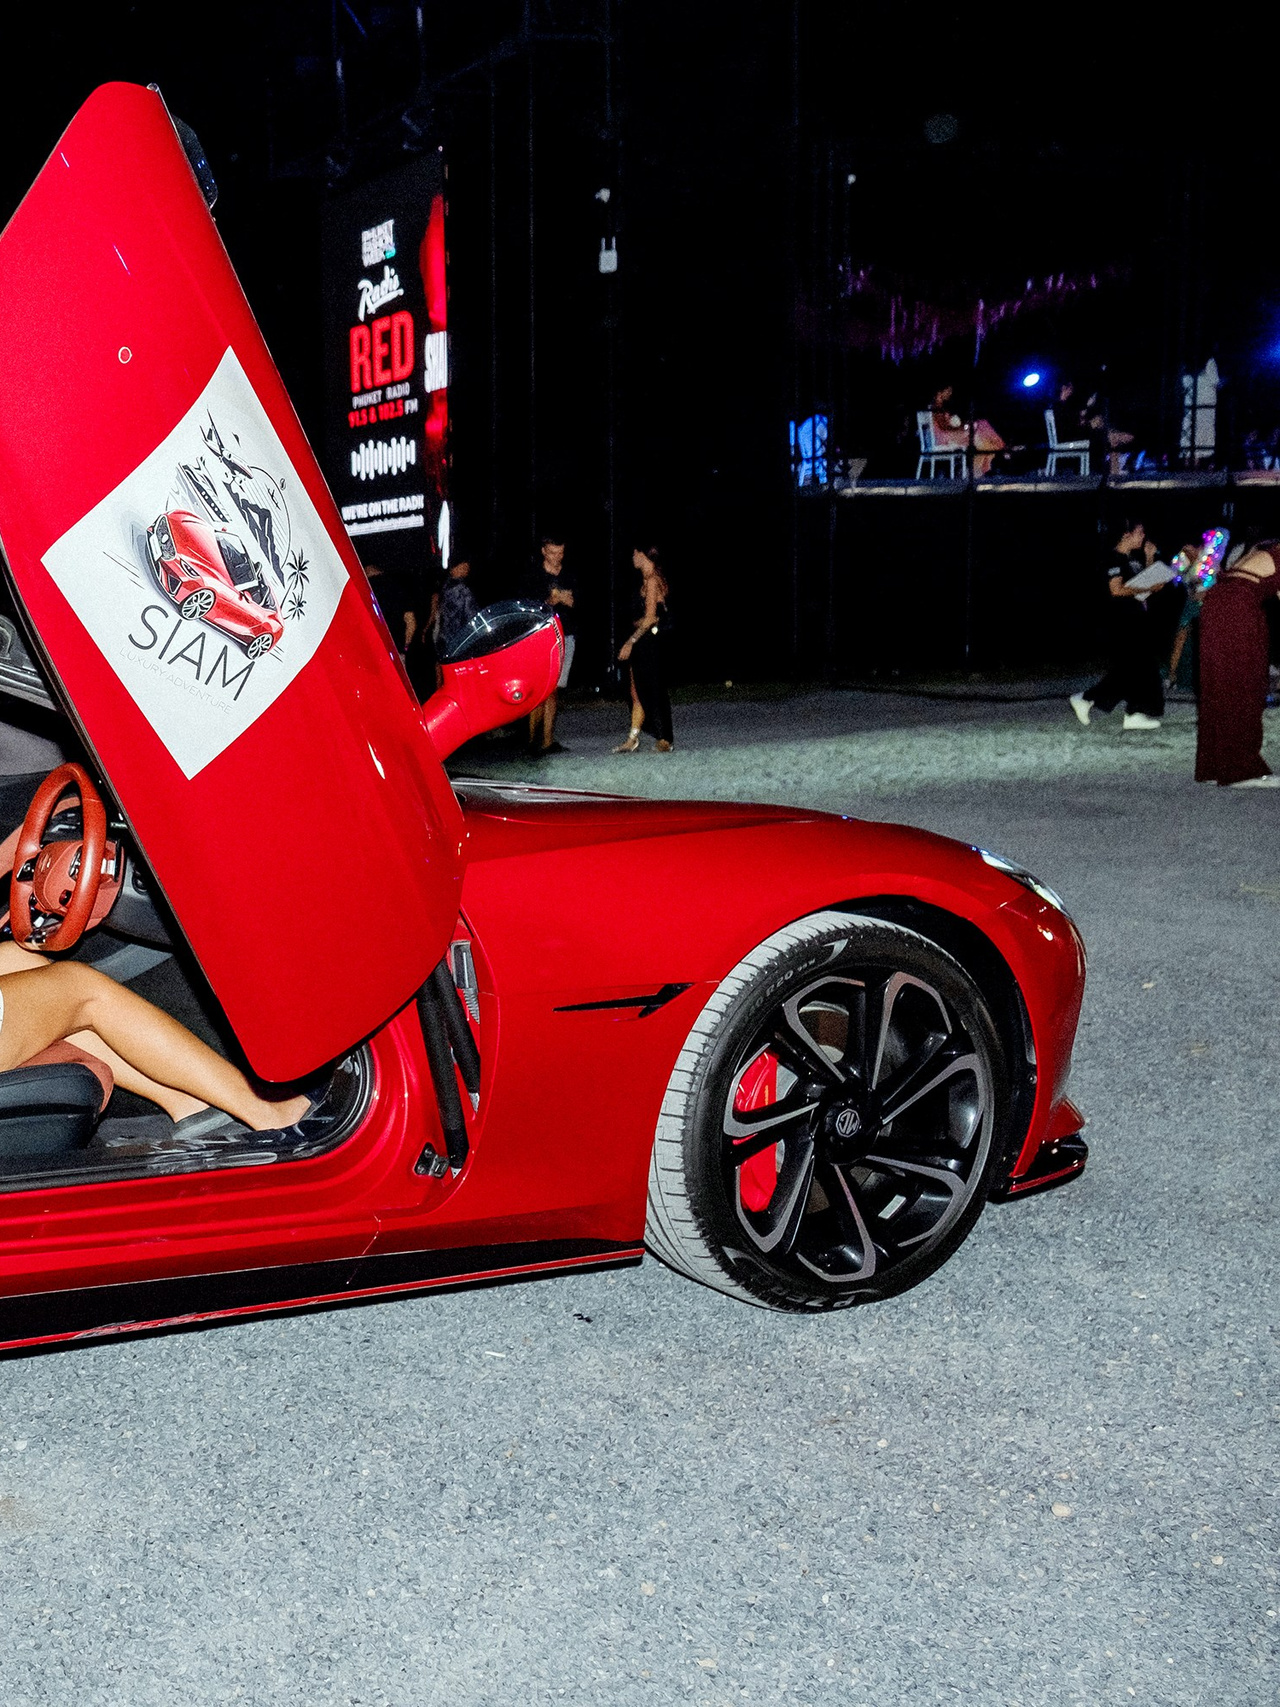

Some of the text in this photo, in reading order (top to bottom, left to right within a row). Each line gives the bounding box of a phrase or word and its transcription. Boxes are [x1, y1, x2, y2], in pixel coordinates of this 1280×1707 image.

[349, 310, 415, 393] RED
[348, 408, 367, 428] 91.5
[378, 399, 404, 421] 102.5
[404, 398, 418, 415] FM
[352, 382, 410, 410] PHUKET RADIO
[368, 500, 381, 517] ON
[381, 498, 399, 515] THE
[128, 604, 255, 701] SIAM
[120, 647, 234, 715] LUXURY ADVENTURE
